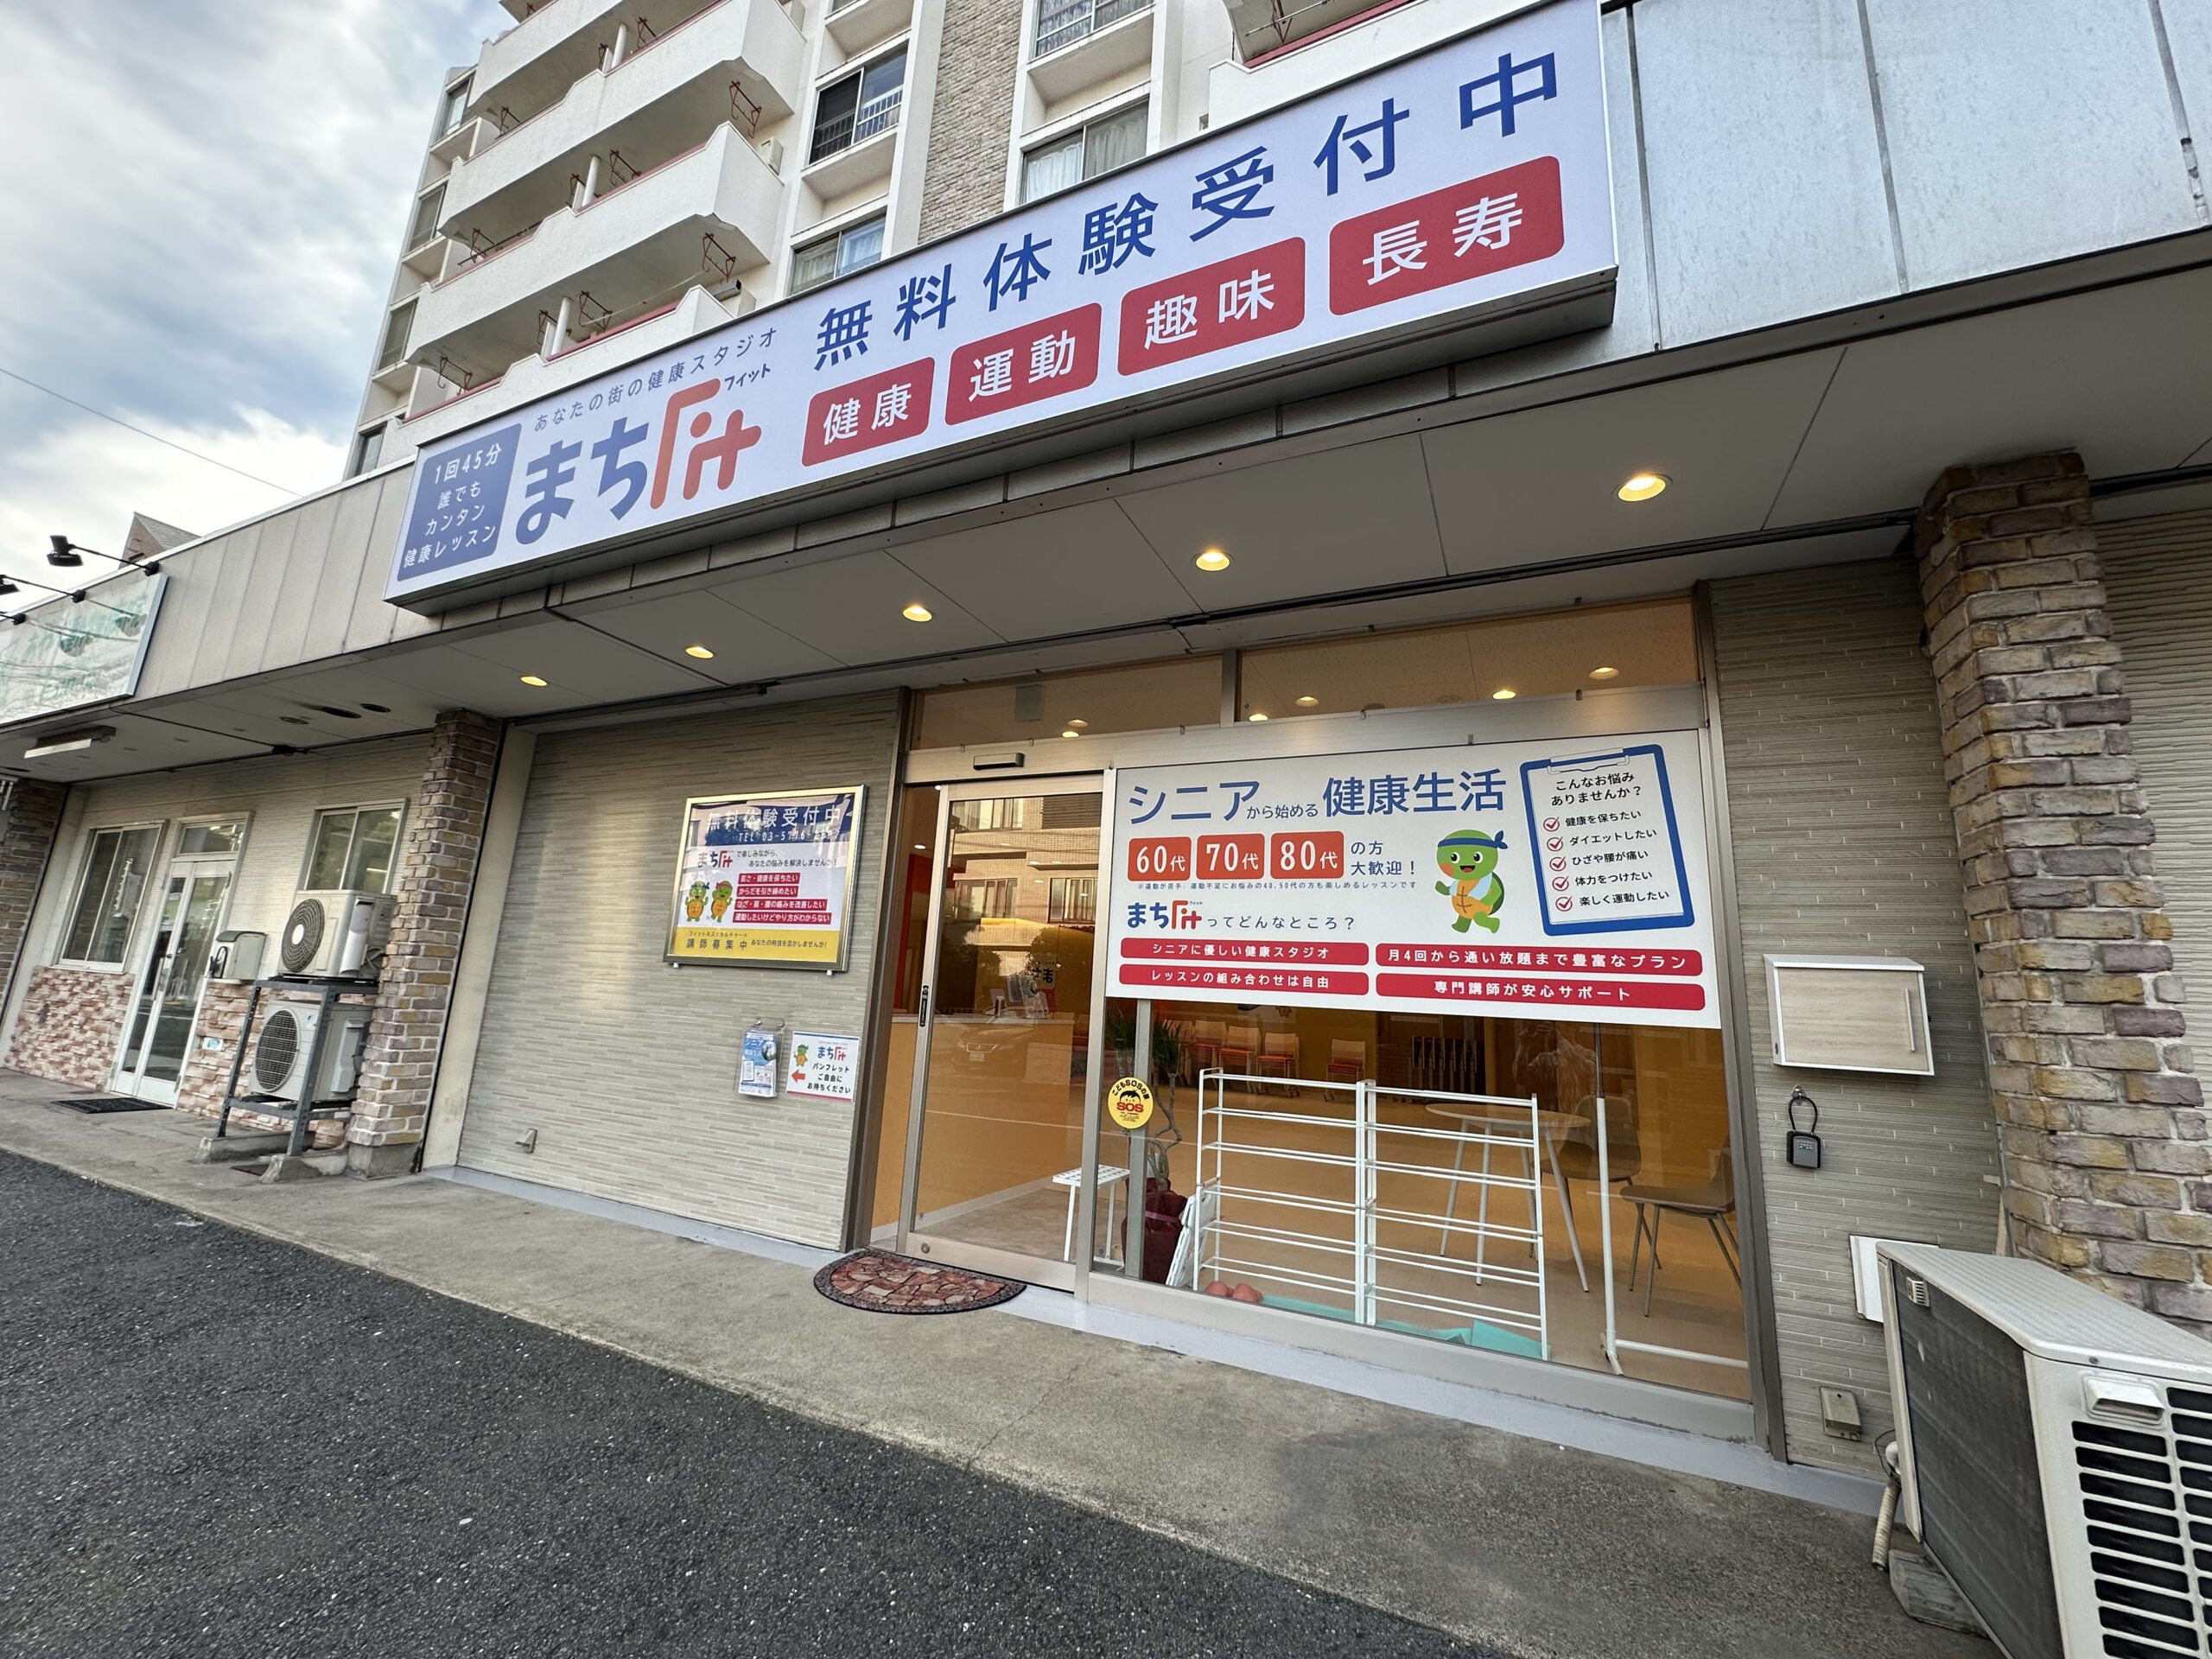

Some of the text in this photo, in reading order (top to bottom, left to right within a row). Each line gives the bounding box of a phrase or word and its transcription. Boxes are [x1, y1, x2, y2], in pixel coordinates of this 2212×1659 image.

[813, 53, 1557, 372] 無料体験受付中
[823, 192, 1524, 447] 健康 運動 趣味 長寿
[534, 327, 777, 432] あなたの街の健康スタジオ
[724, 363, 772, 391] フィット
[435, 442, 502, 484] 1回45分
[437, 481, 481, 510] 誰でも
[425, 505, 486, 536] カンタン
[404, 525, 496, 569] 健康レッスン
[1555, 772, 1635, 791] こんなお悩み
[1551, 785, 1641, 807] ありませんか？
[1565, 810, 1641, 828] 健康を保ちたい
[739, 832, 754, 842] TEL
[1569, 829, 1657, 847] ダイエットしたい
[1136, 840, 1384, 874] 60代 70代 80代 の方
[1572, 850, 1649, 867] ひざや腰が痛い
[1351, 860, 1416, 876] 大歓迎！
[1575, 871, 1653, 887] 体力をつけたい
[1580, 891, 1669, 907] 楽しく運動したい
[1152, 943, 1330, 959] シニアに優しい健康スタジオ
[1387, 949, 1687, 969] 月4回から通い放題まで豊富なプラン
[1151, 969, 1330, 989] レッスンの組み合わせは自由
[1433, 980, 1631, 1001] 専門講師が安心サポート
[812, 1063, 850, 1073] パンフレット
[817, 1073, 843, 1083] ご自由に
[807, 1082, 851, 1094] お持ちください
[1116, 1102, 1144, 1113] SOS
